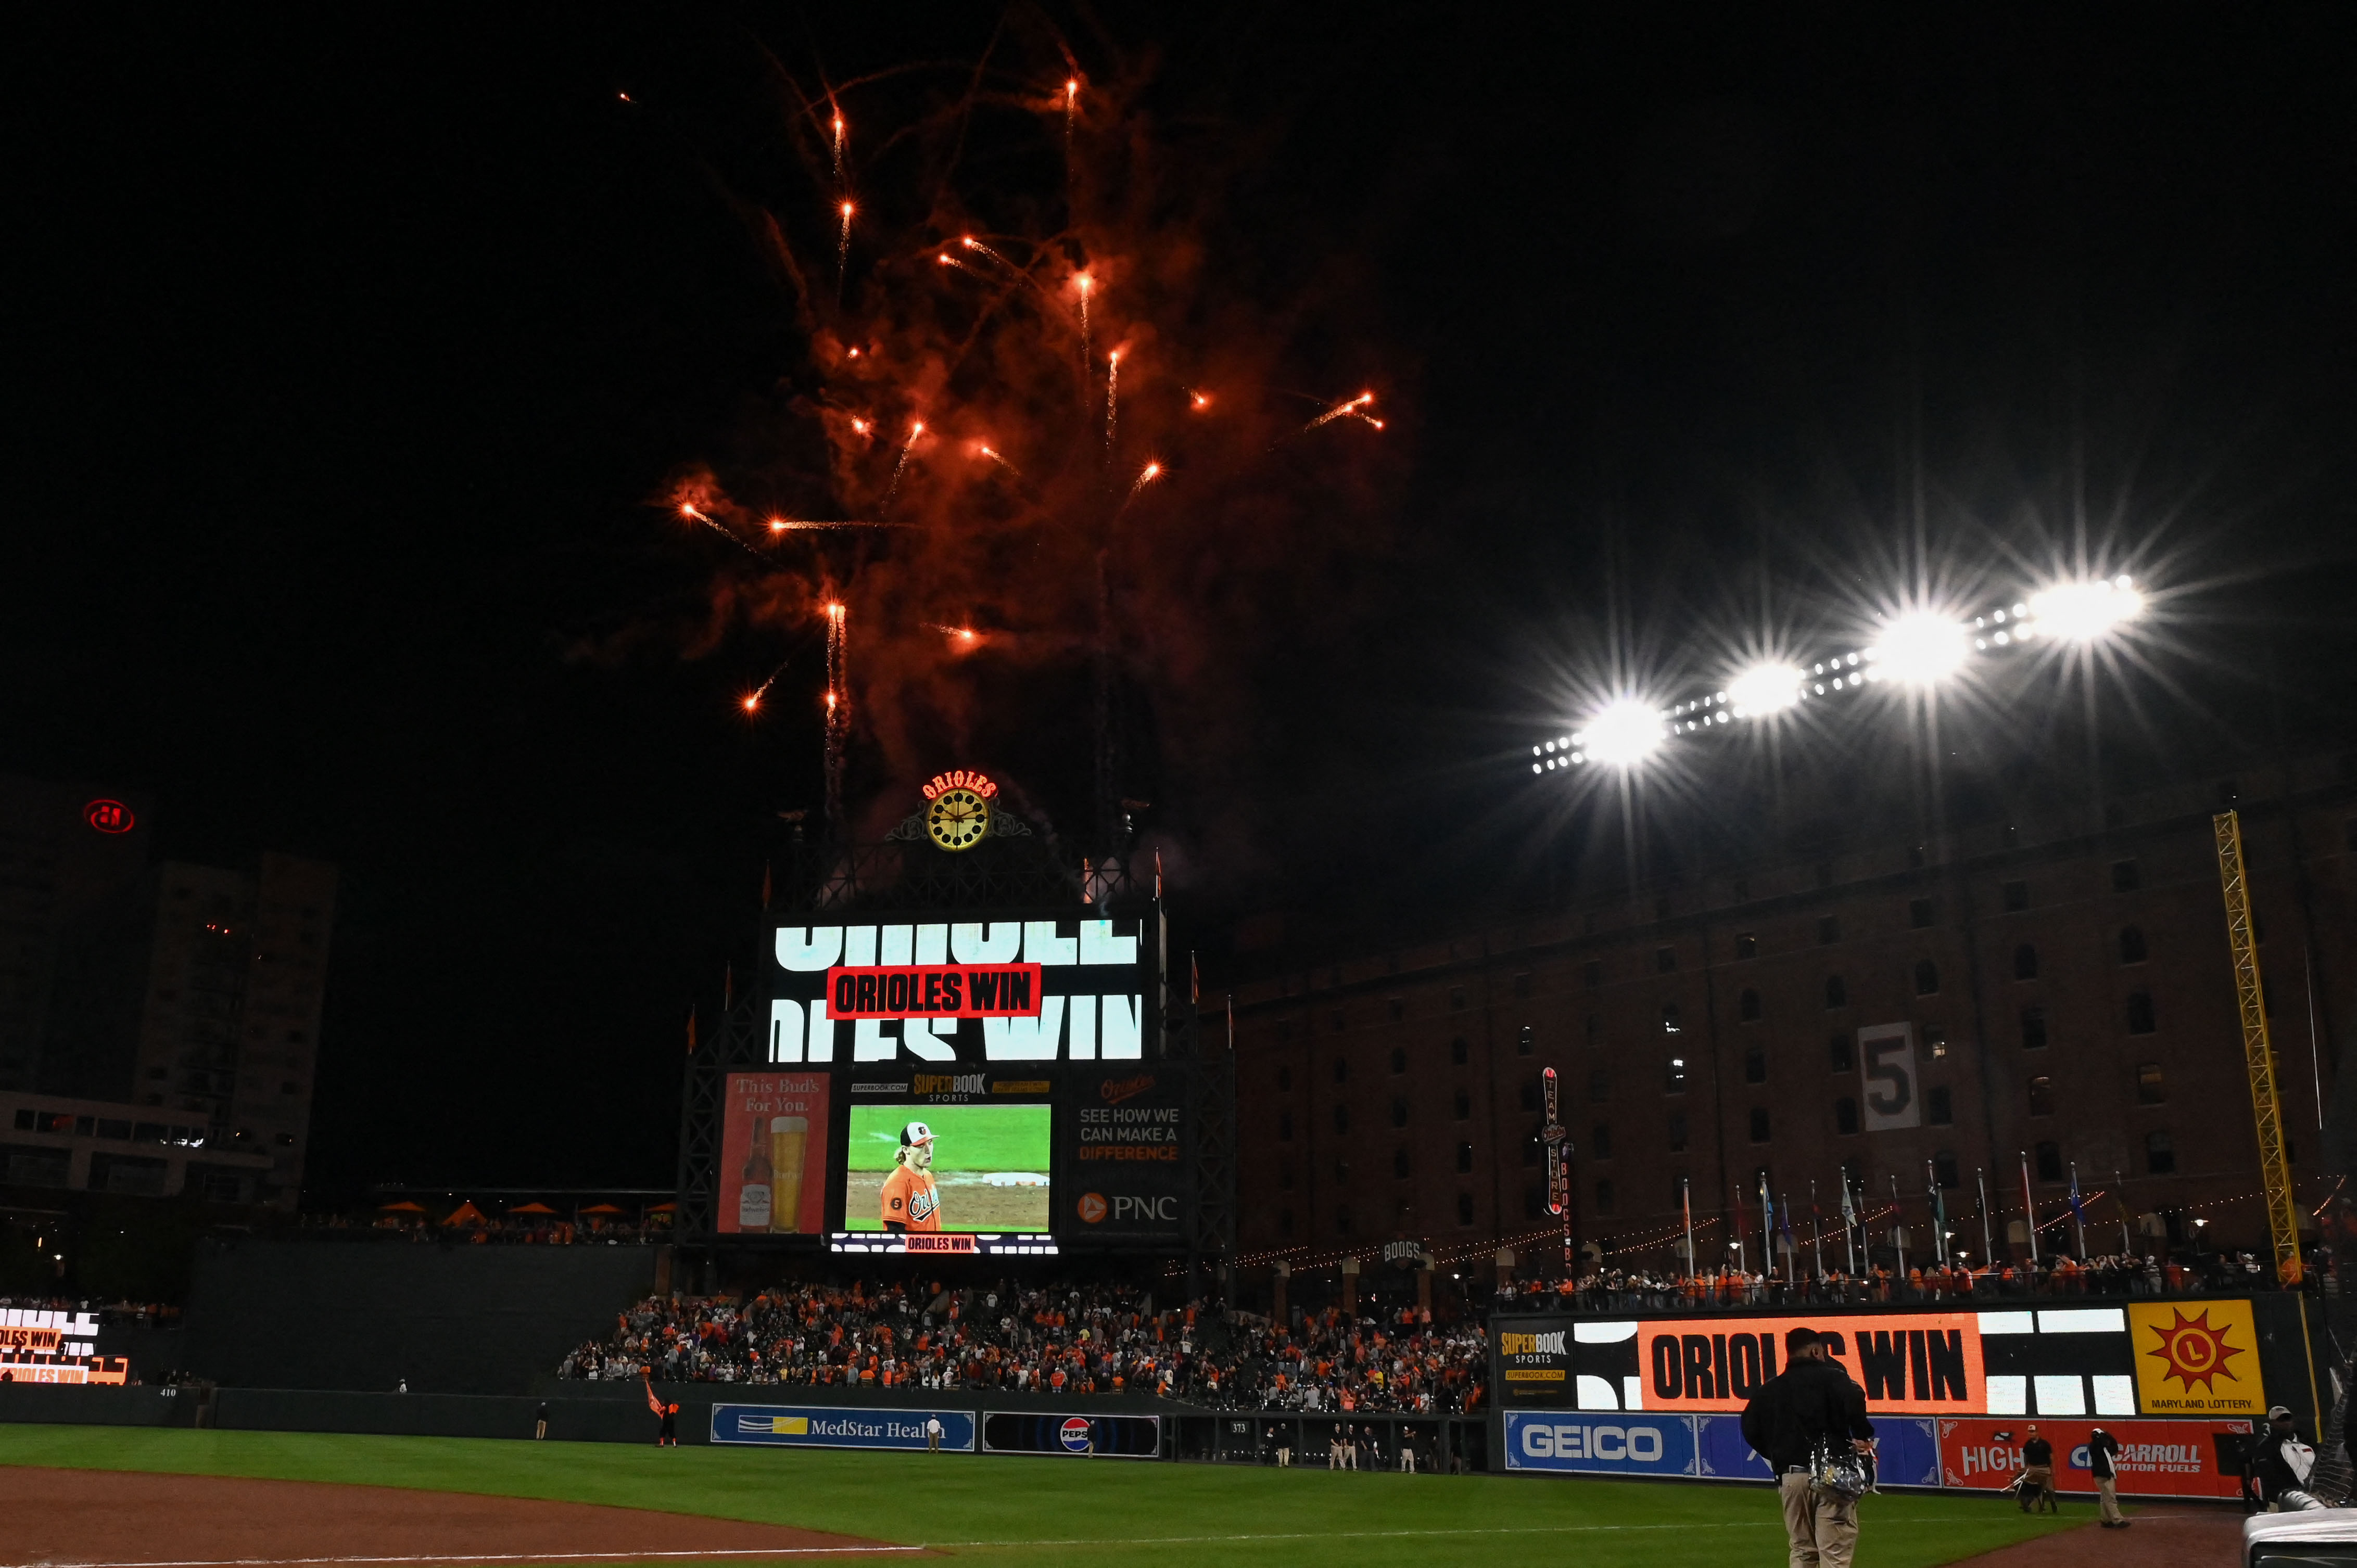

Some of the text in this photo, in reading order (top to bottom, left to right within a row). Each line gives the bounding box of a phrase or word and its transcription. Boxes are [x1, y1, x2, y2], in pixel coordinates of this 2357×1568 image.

[923, 770, 997, 799] ORIOLES
[835, 971, 1031, 1013] ORIOLES WIN
[1864, 1035, 1911, 1116] 5
[737, 1078, 820, 1093] This Bud's
[914, 1073, 986, 1094] SUPERBOOK
[745, 1097, 808, 1112] For You.
[1545, 1080, 1555, 1121] TEAM
[1080, 1108, 1179, 1123] SEE HOW WE
[1081, 1127, 1177, 1141] CAN MAKE A
[1079, 1146, 1178, 1161] DIFFERENCE
[1551, 1149, 1560, 1201] STORE
[1112, 1196, 1178, 1220] PNC
[908, 1237, 971, 1250] ORIOLES WIN
[31, 1331, 57, 1347] WIN
[1501, 1331, 1566, 1356] SUPERBOOK
[1515, 1355, 1551, 1363] SPORTS
[1855, 1329, 1968, 1401] WIN
[58, 1369, 84, 1384] WIN
[160, 1388, 176, 1397] 410
[2151, 1399, 2252, 1409] MARYLAND LOTTERY
[811, 1419, 883, 1437] MedStar
[1233, 1423, 1246, 1433] 373
[1522, 1424, 1663, 1462] GEICO
[2160, 1463, 2201, 1473] FUELS
